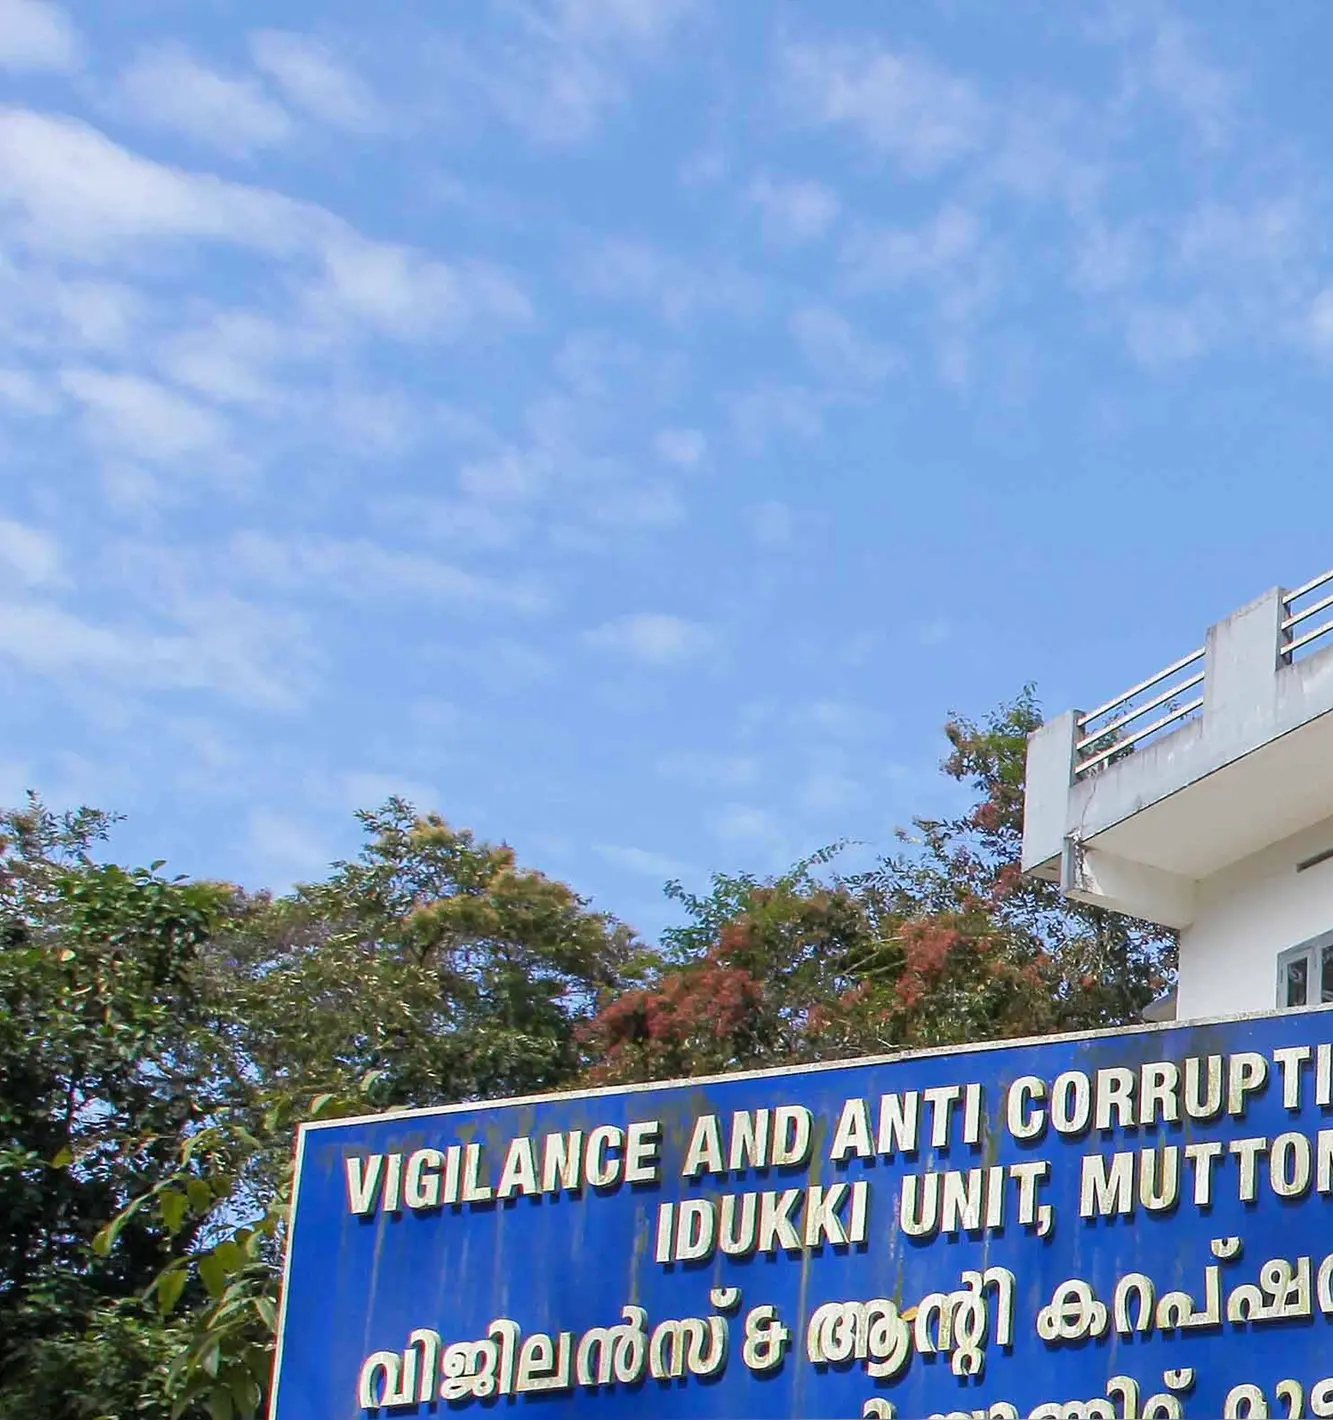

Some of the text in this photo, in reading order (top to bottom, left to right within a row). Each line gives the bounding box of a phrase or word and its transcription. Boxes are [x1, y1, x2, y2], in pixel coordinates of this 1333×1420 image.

[345, 1120, 661, 1216] VIGILANCE
[681, 1104, 813, 1178] AND
[830, 1082, 982, 1161] ANTI
[655, 1180, 870, 1264] IDUKKI
[899, 1160, 1054, 1237] UNIT,
[742, 1304, 790, 1370] &
